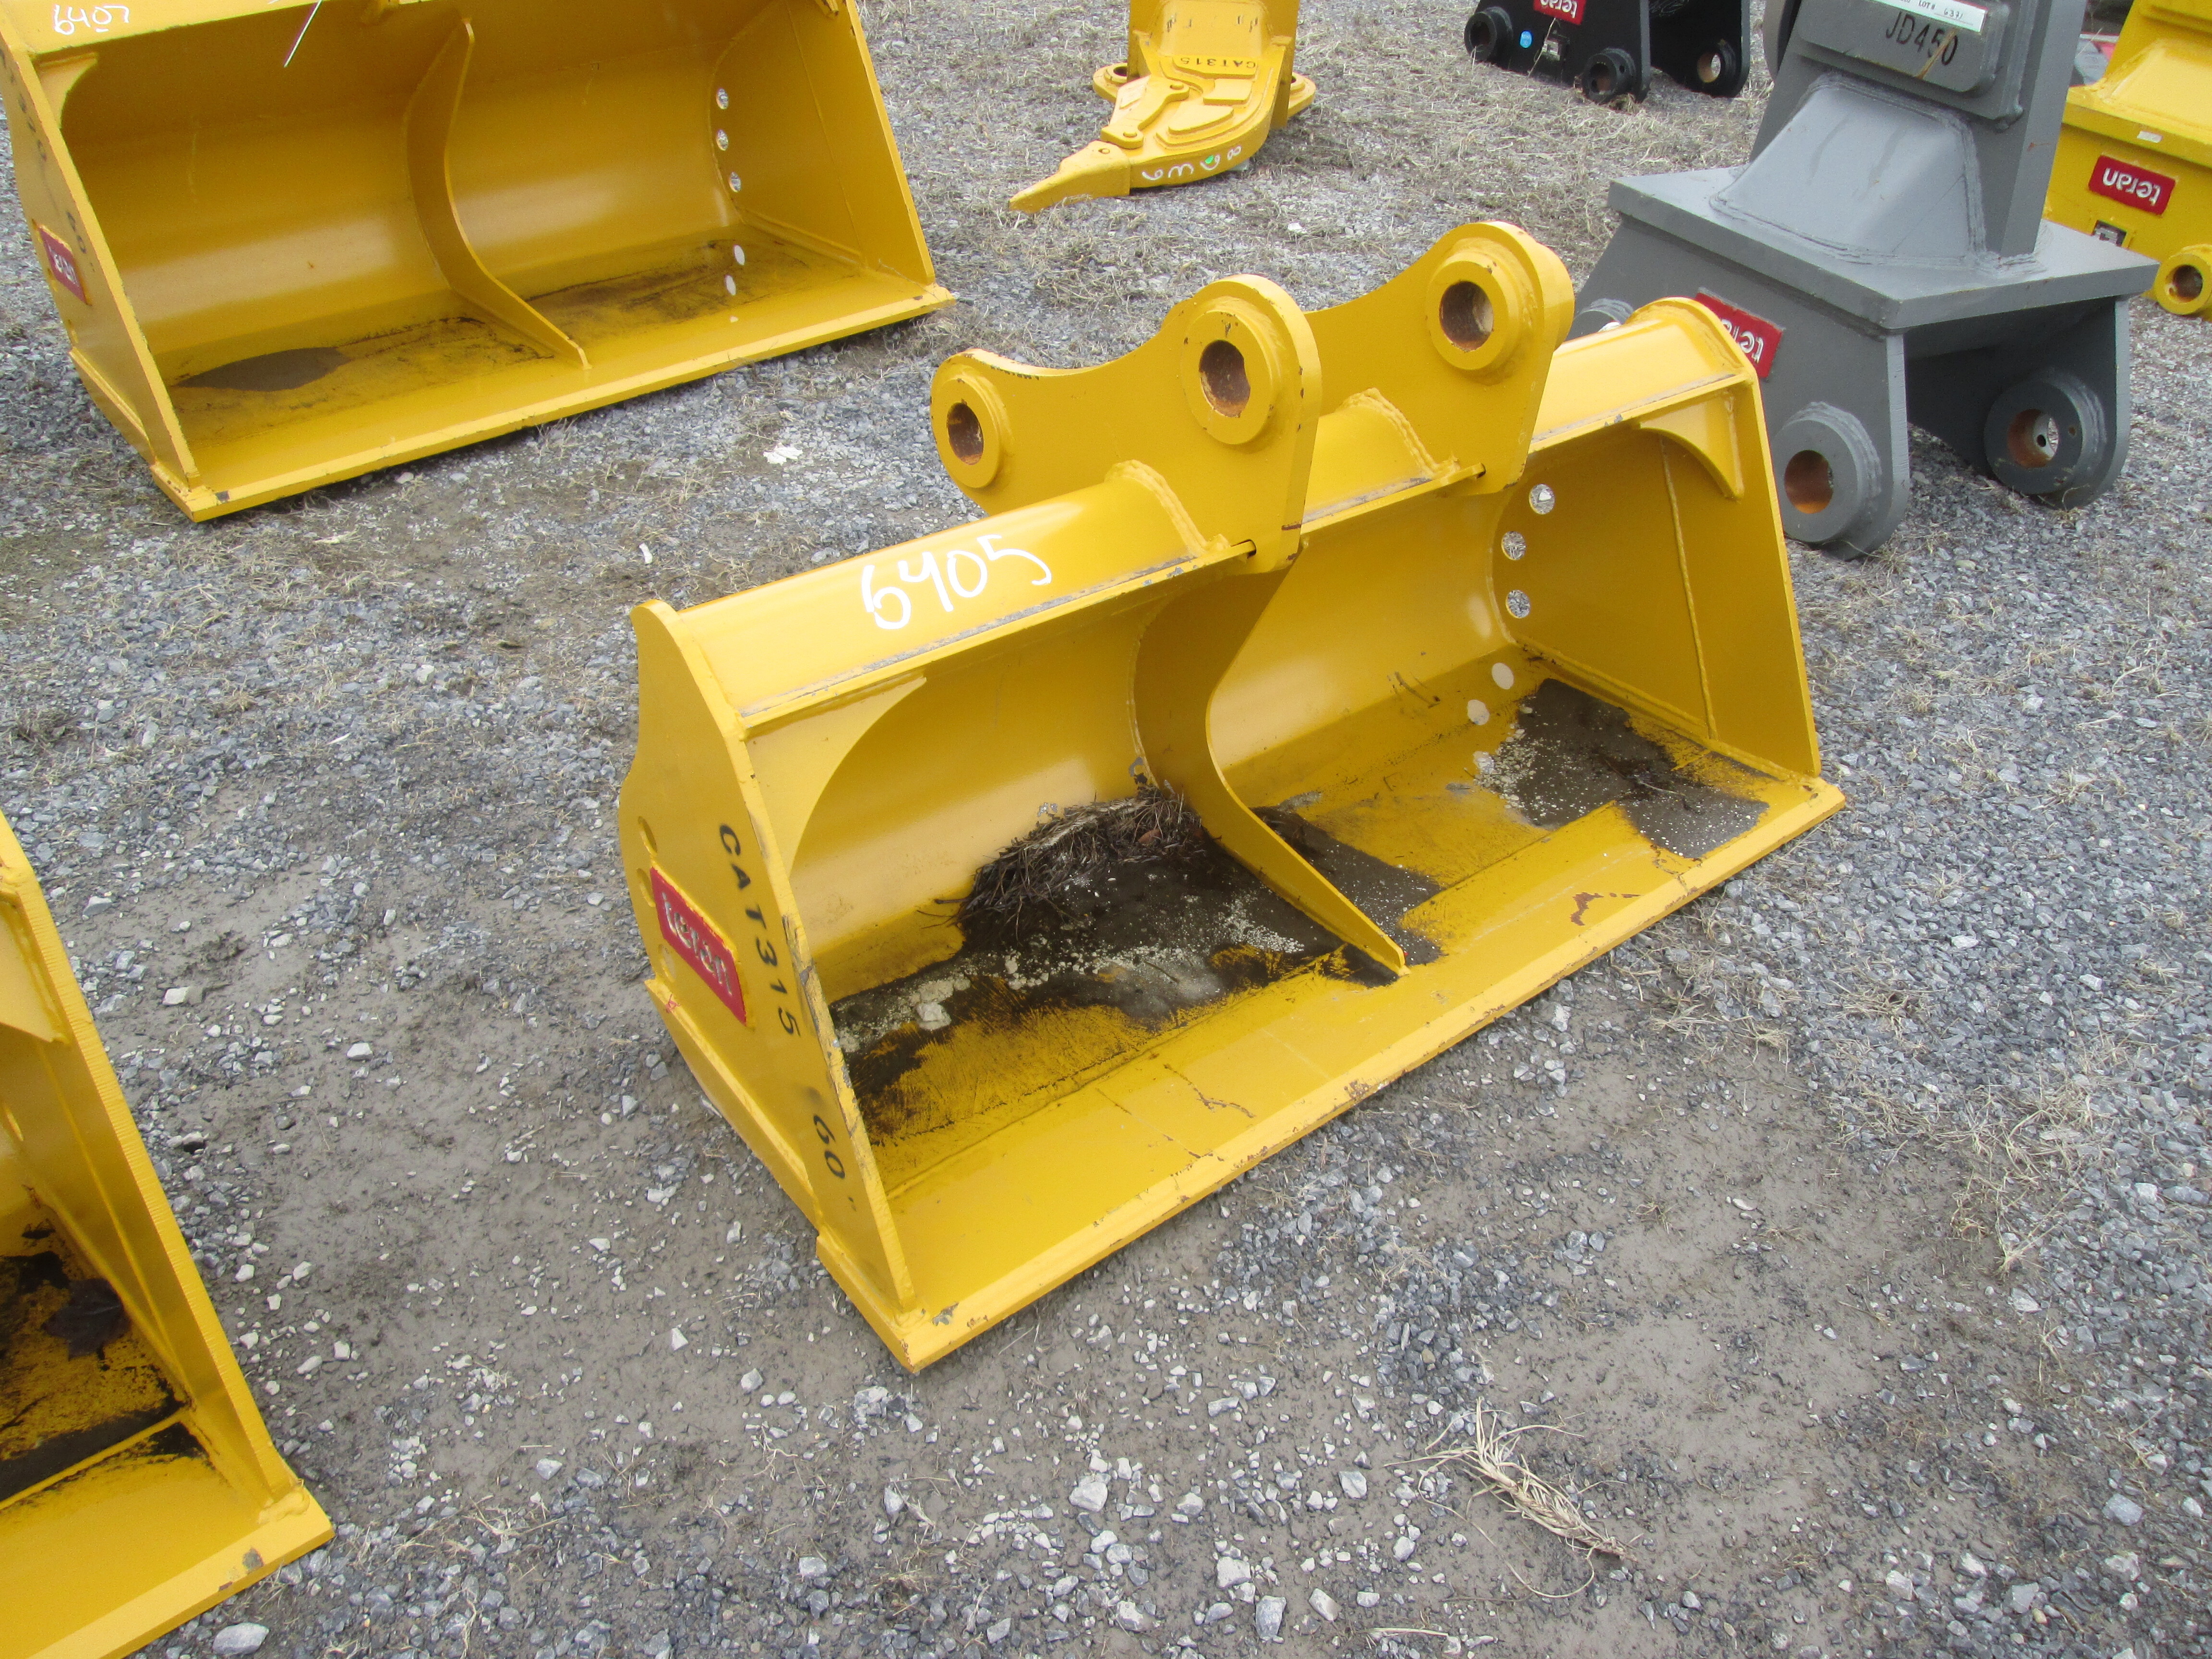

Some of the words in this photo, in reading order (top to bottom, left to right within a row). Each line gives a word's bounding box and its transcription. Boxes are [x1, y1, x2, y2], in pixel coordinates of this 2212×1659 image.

[53, 4, 130, 35] 6407
[1886, 11, 1959, 66] JD450
[1180, 57, 1256, 69] CAT315
[2102, 167, 2161, 206] teran
[861, 534, 1052, 630] 6405
[662, 891, 733, 996] teran
[719, 824, 801, 1037] CAT315
